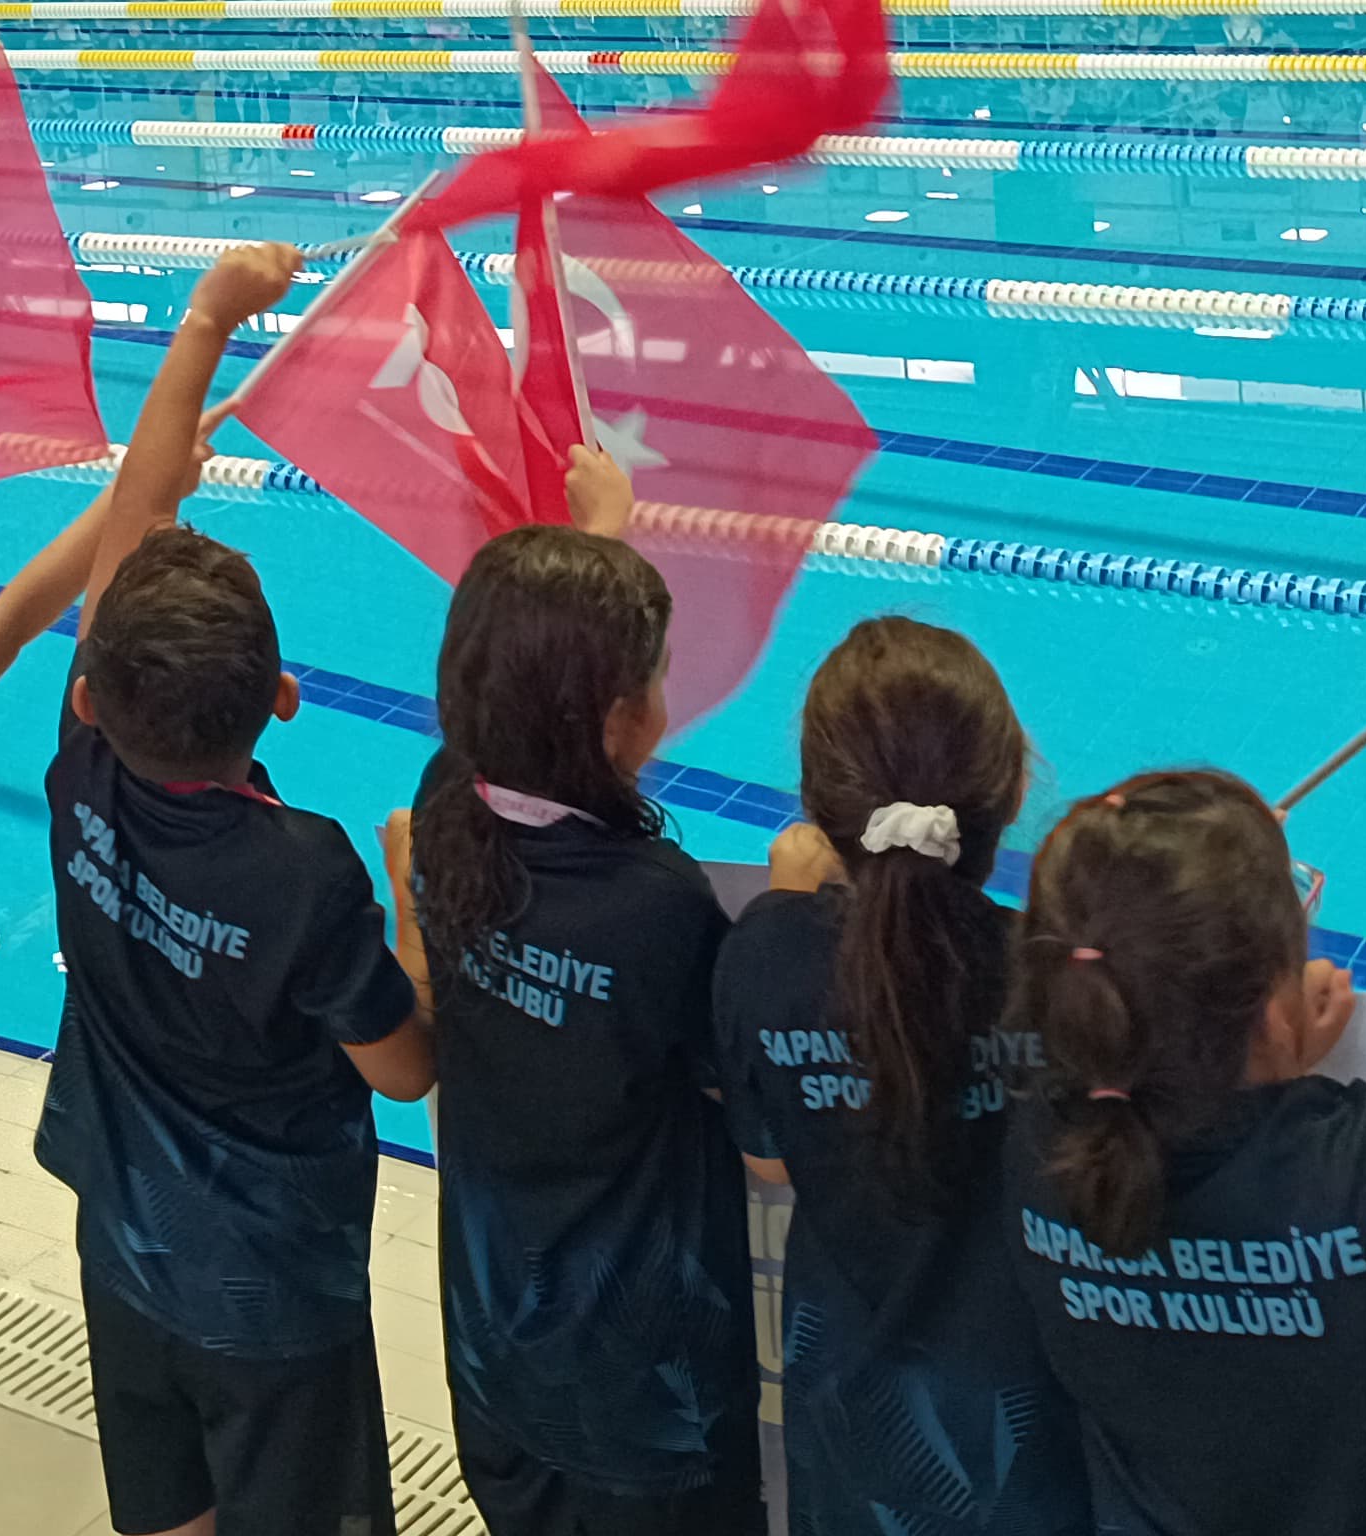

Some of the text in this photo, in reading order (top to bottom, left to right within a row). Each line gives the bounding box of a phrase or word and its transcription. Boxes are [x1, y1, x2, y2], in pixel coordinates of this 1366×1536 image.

[136, 872, 251, 960] BELEDİYE
[485, 928, 613, 1001] ELEDİYE
[759, 1028, 853, 1066] SAPAN
[1060, 1277, 1325, 1338] SPOR KULÜBÜ
